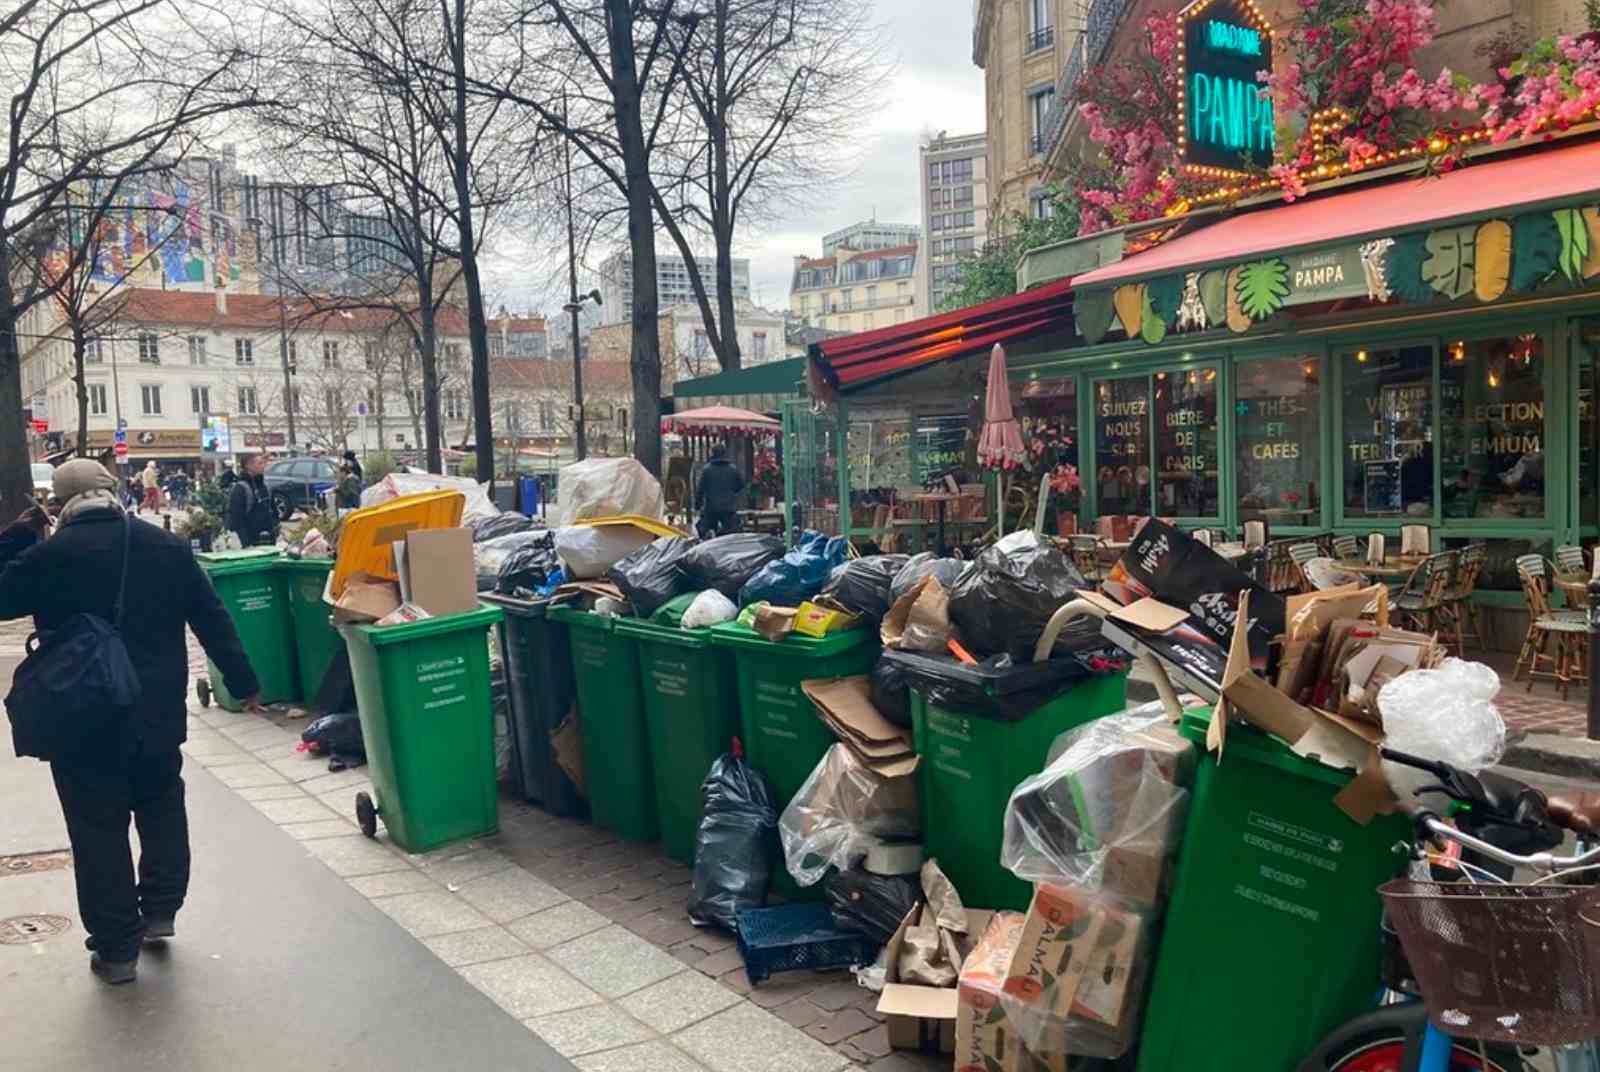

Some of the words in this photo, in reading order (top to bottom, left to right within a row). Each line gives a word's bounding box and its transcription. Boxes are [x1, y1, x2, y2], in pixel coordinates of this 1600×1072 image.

[1194, 72, 1274, 151] PAMPA
[1295, 264, 1345, 288] PAMPA
[1102, 399, 1147, 417] SUIVEZ
[1105, 421, 1141, 437] NOUS
[1175, 431, 1194, 447] DE
[1252, 440, 1299, 459] CAFÉS
[1166, 455, 1205, 471] PARIS
[1198, 592, 1259, 632] Asai
[970, 992, 986, 1064] DALMA
